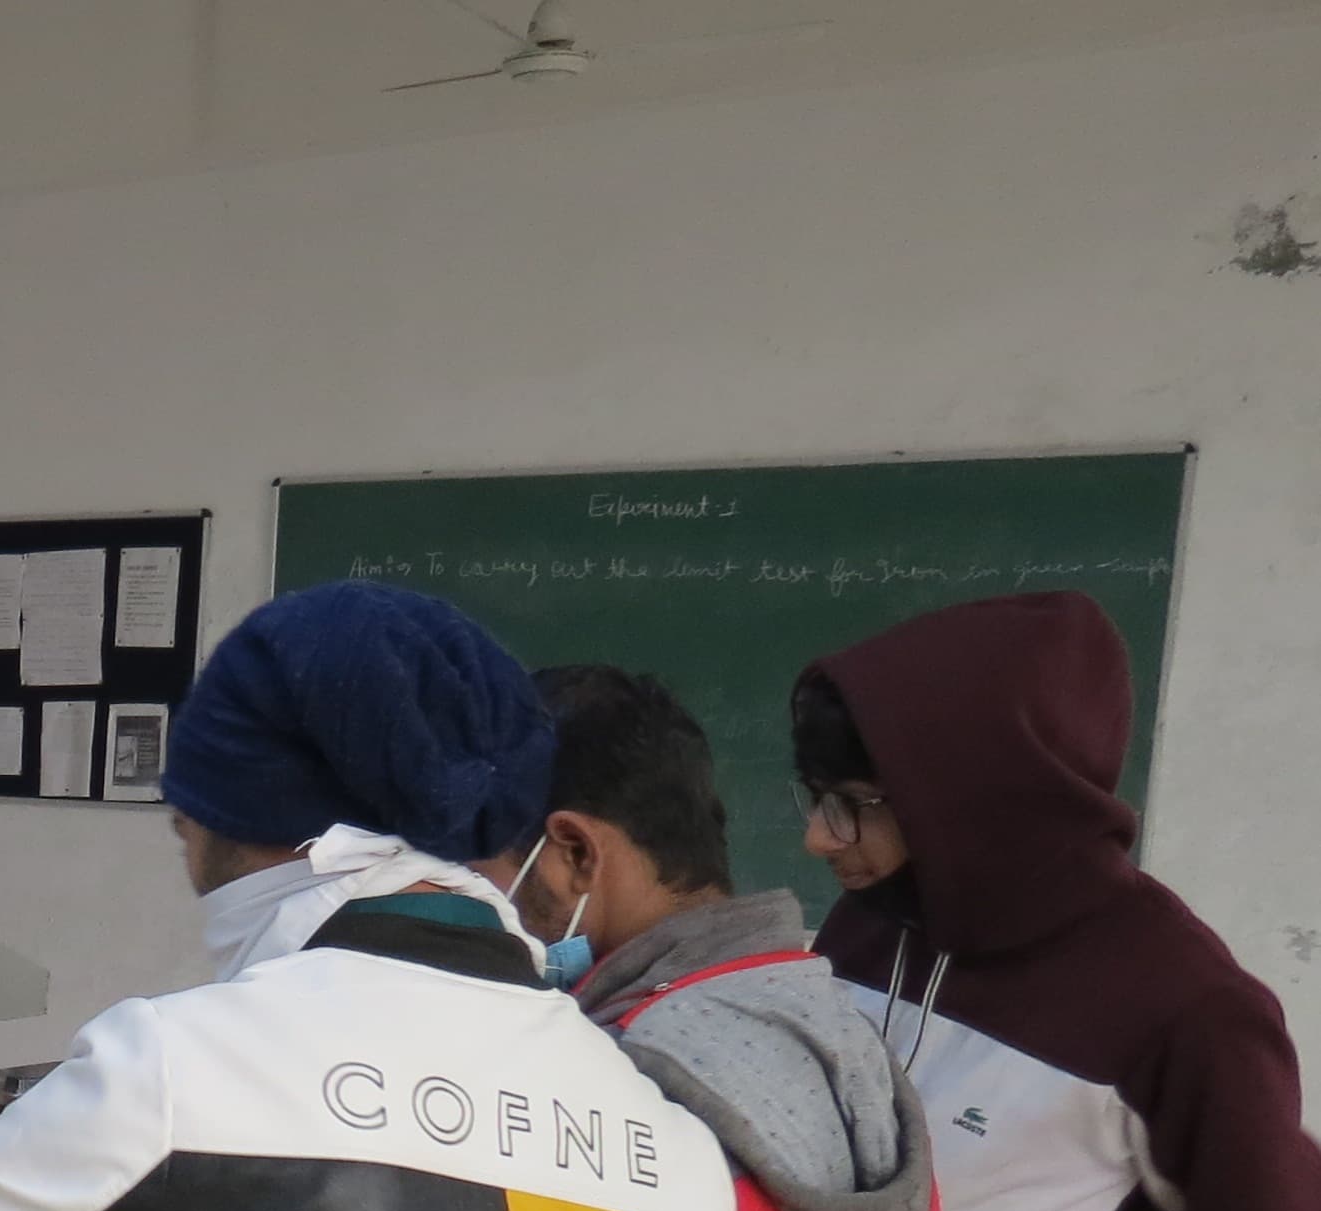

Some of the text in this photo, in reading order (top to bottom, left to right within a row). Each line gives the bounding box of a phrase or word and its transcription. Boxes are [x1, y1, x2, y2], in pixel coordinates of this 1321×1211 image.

[604, 556, 648, 580] the
[749, 556, 816, 583] test
[322, 1061, 659, 1188] COFNE
